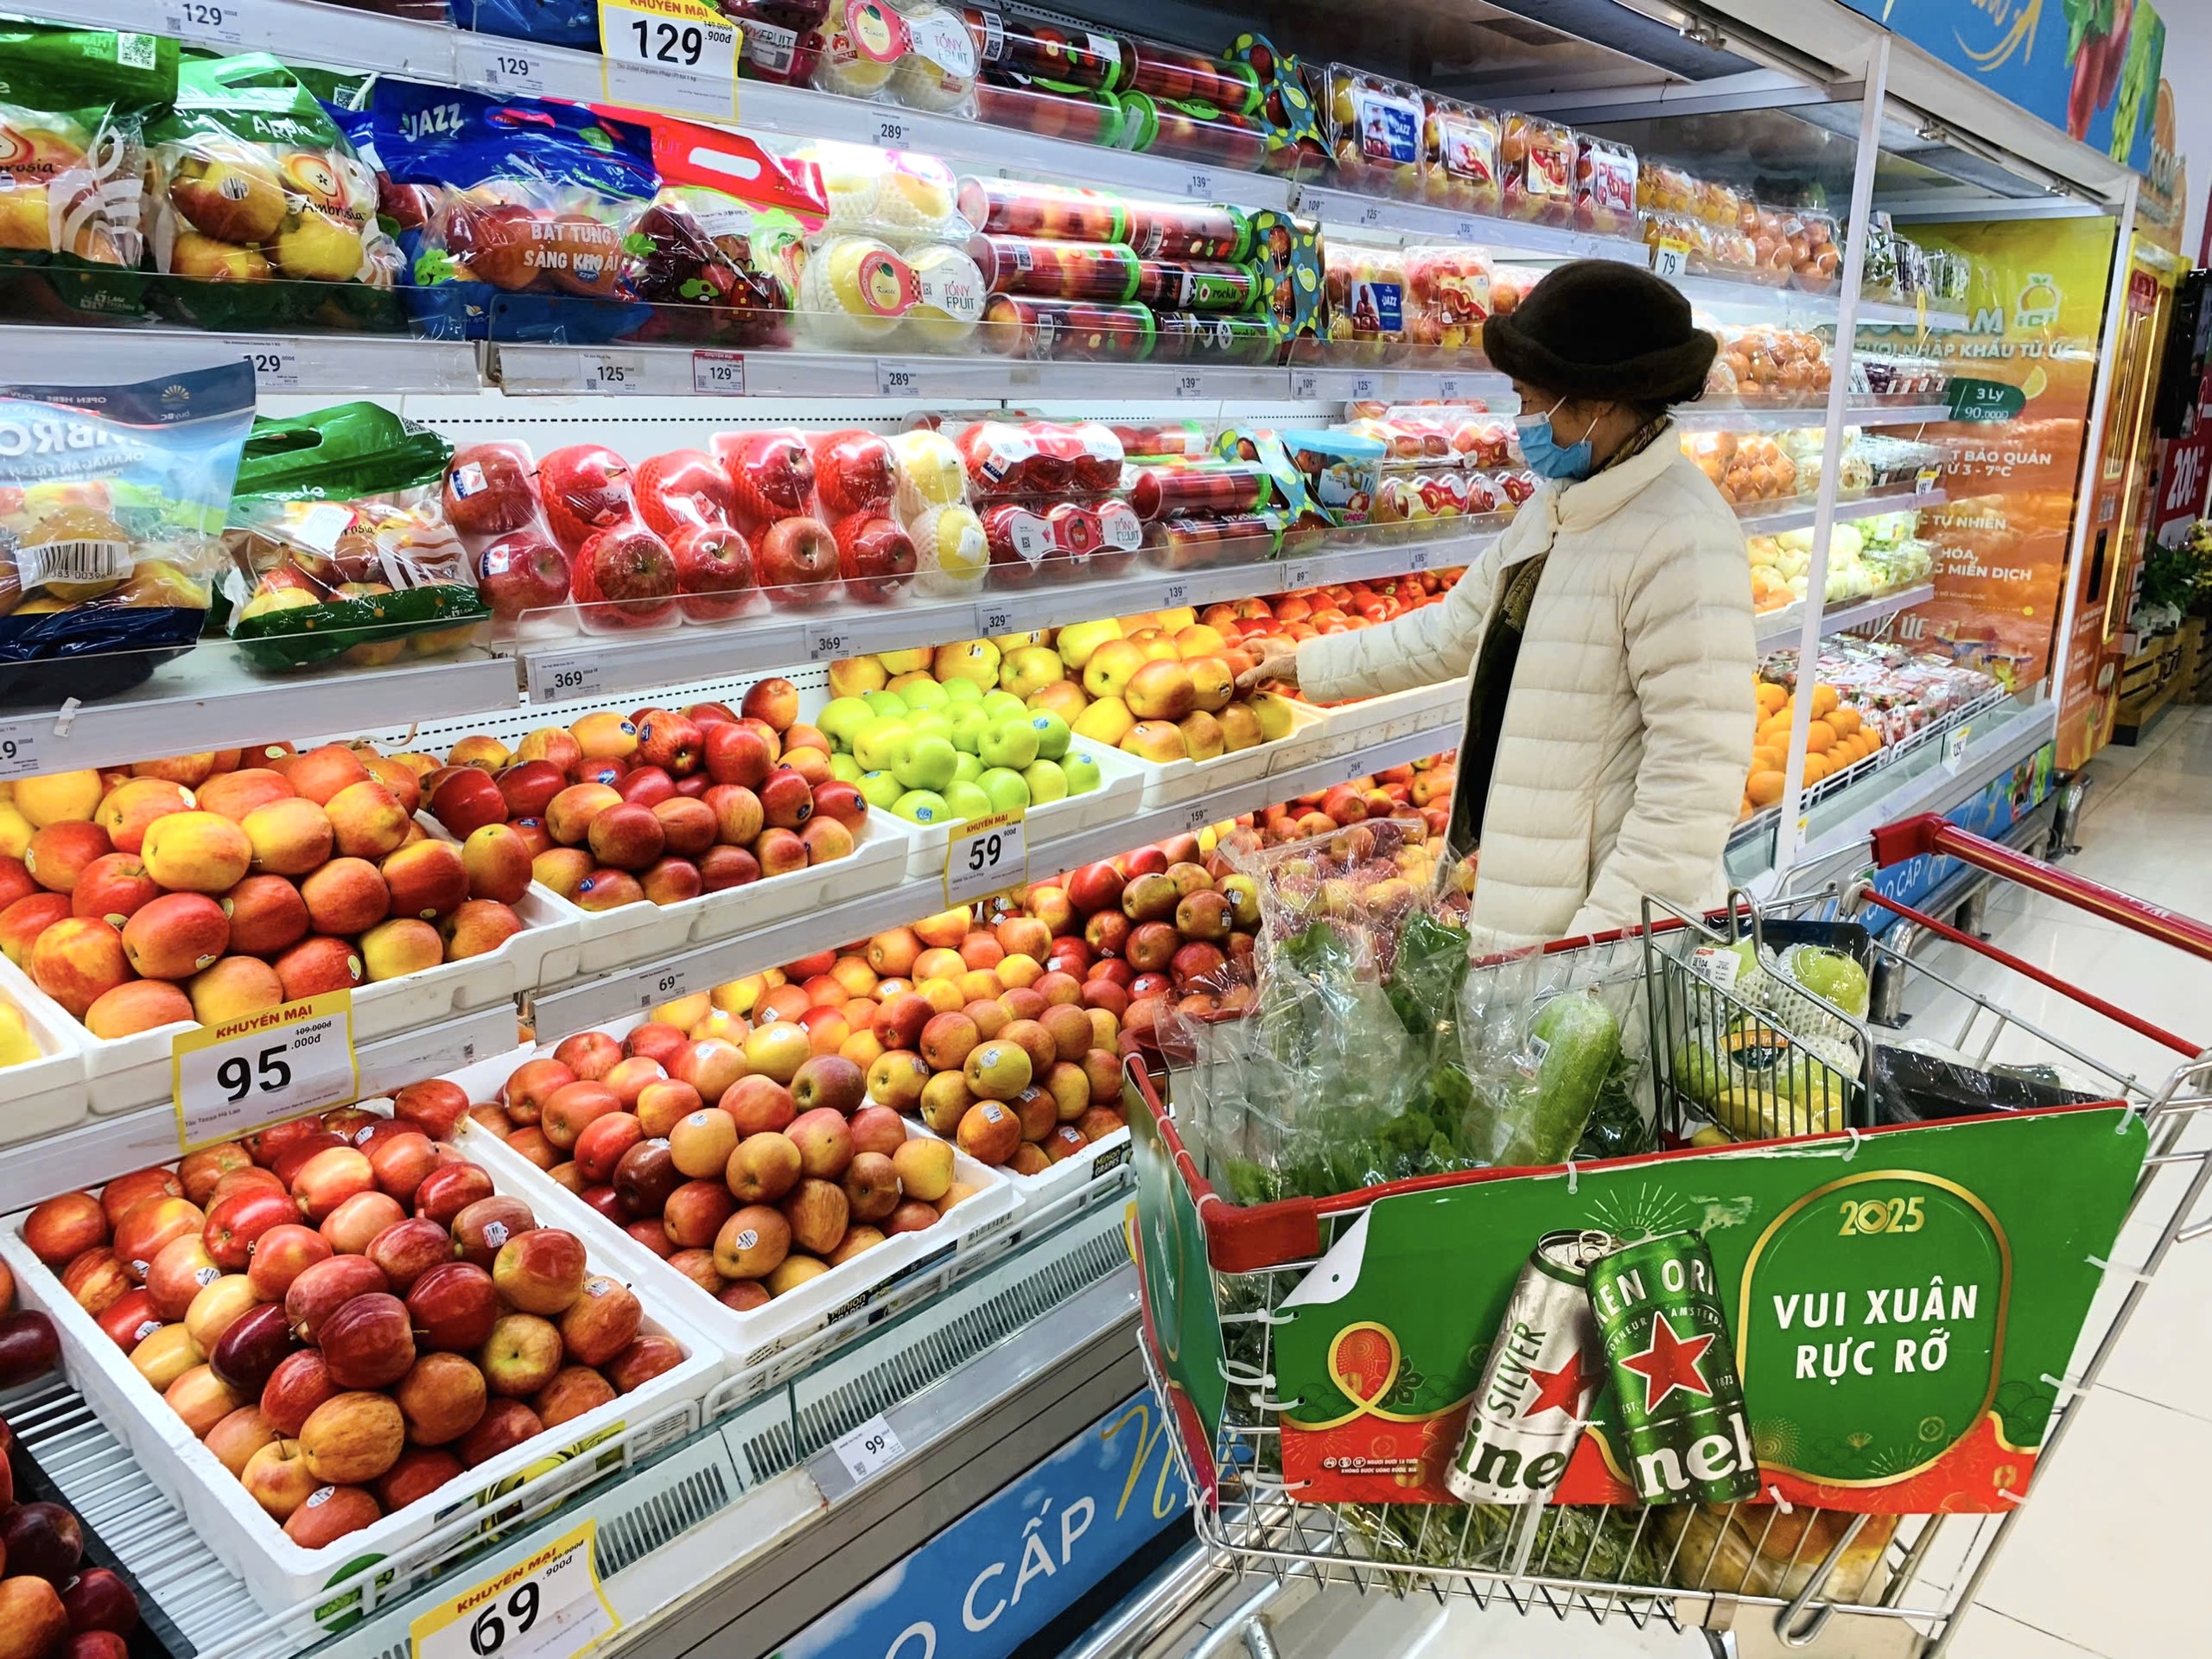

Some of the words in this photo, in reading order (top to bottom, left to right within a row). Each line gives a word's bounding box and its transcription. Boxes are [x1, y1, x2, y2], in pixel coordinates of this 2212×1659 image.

[182, 3, 222, 26] 129
[685, 4, 709, 19] MẠI
[632, 20, 702, 66] 129
[704, 32, 732, 44] .900đ
[934, 33, 963, 49] TÓNY
[938, 49, 968, 66] FRUIT
[498, 56, 529, 76] 129
[253, 115, 313, 142] Apple
[404, 103, 464, 143] JAZZ
[881, 124, 902, 139] 289
[1192, 176, 1206, 188] 139
[302, 198, 364, 222] Ambrosia
[1308, 200, 1319, 211] 109
[1367, 209, 1377, 219] 125
[531, 224, 564, 245] BẠT
[570, 226, 613, 245] TỤNG
[524, 239, 568, 270] SẢNG
[1662, 253, 1676, 275] 79
[944, 281, 970, 297] TÓNY
[1212, 287, 1237, 300] rockit
[946, 296, 975, 311] FRUIT
[1382, 296, 1397, 307] JAZZ
[597, 366, 624, 381] 125
[709, 366, 732, 380] 129
[889, 372, 908, 385] 289
[1181, 378, 1195, 388] 139
[1303, 379, 1313, 388] 109
[1357, 381, 1368, 391] 125
[1445, 382, 1454, 391] 135
[1977, 389, 1986, 399] 3
[1988, 389, 2005, 403] Ly
[1964, 448, 1999, 463] BẢO
[2004, 448, 2052, 466] QUẢN
[1962, 465, 1971, 475] 3
[2166, 447, 2198, 511] 200
[1115, 518, 1136, 531] TÓNY
[1414, 554, 1425, 563] 135
[1297, 571, 1306, 582] 89
[1992, 567, 2033, 582] DỊCH
[1169, 588, 1183, 598] 139
[989, 614, 1006, 628] 329
[819, 637, 841, 651] 369
[555, 671, 583, 688] 369
[0, 741, 17, 760] 9
[1191, 810, 1205, 822] 159
[969, 834, 1001, 871] 59
[659, 976, 675, 991] 69
[216, 1012, 281, 1039] KHUYẾN
[284, 1004, 313, 1020] MẠI
[296, 1020, 332, 1036] 109.000đ
[291, 1034, 321, 1049] .000đ
[217, 1044, 291, 1103] 95
[1096, 1147, 1121, 1166] Minion
[1095, 1158, 1121, 1177] GRAPES
[1838, 1197, 1925, 1236] 2025
[1773, 1291, 1847, 1330] VUI
[1863, 1274, 1978, 1325] XUÂN
[1796, 1336, 1876, 1386] RỰC
[1894, 1327, 1950, 1374] RỠ
[1487, 1322, 1547, 1420] SILVER
[1715, 1374, 1734, 1388] 1873
[1622, 1401, 1640, 1415] EST.
[865, 1435, 885, 1454] 99
[543, 1555, 573, 1580] .900đ
[963, 1496, 1096, 1633] CẤP
[457, 1566, 524, 1614] KHUYẾN
[528, 1547, 557, 1572] MẠI
[470, 1581, 540, 1656] 69
